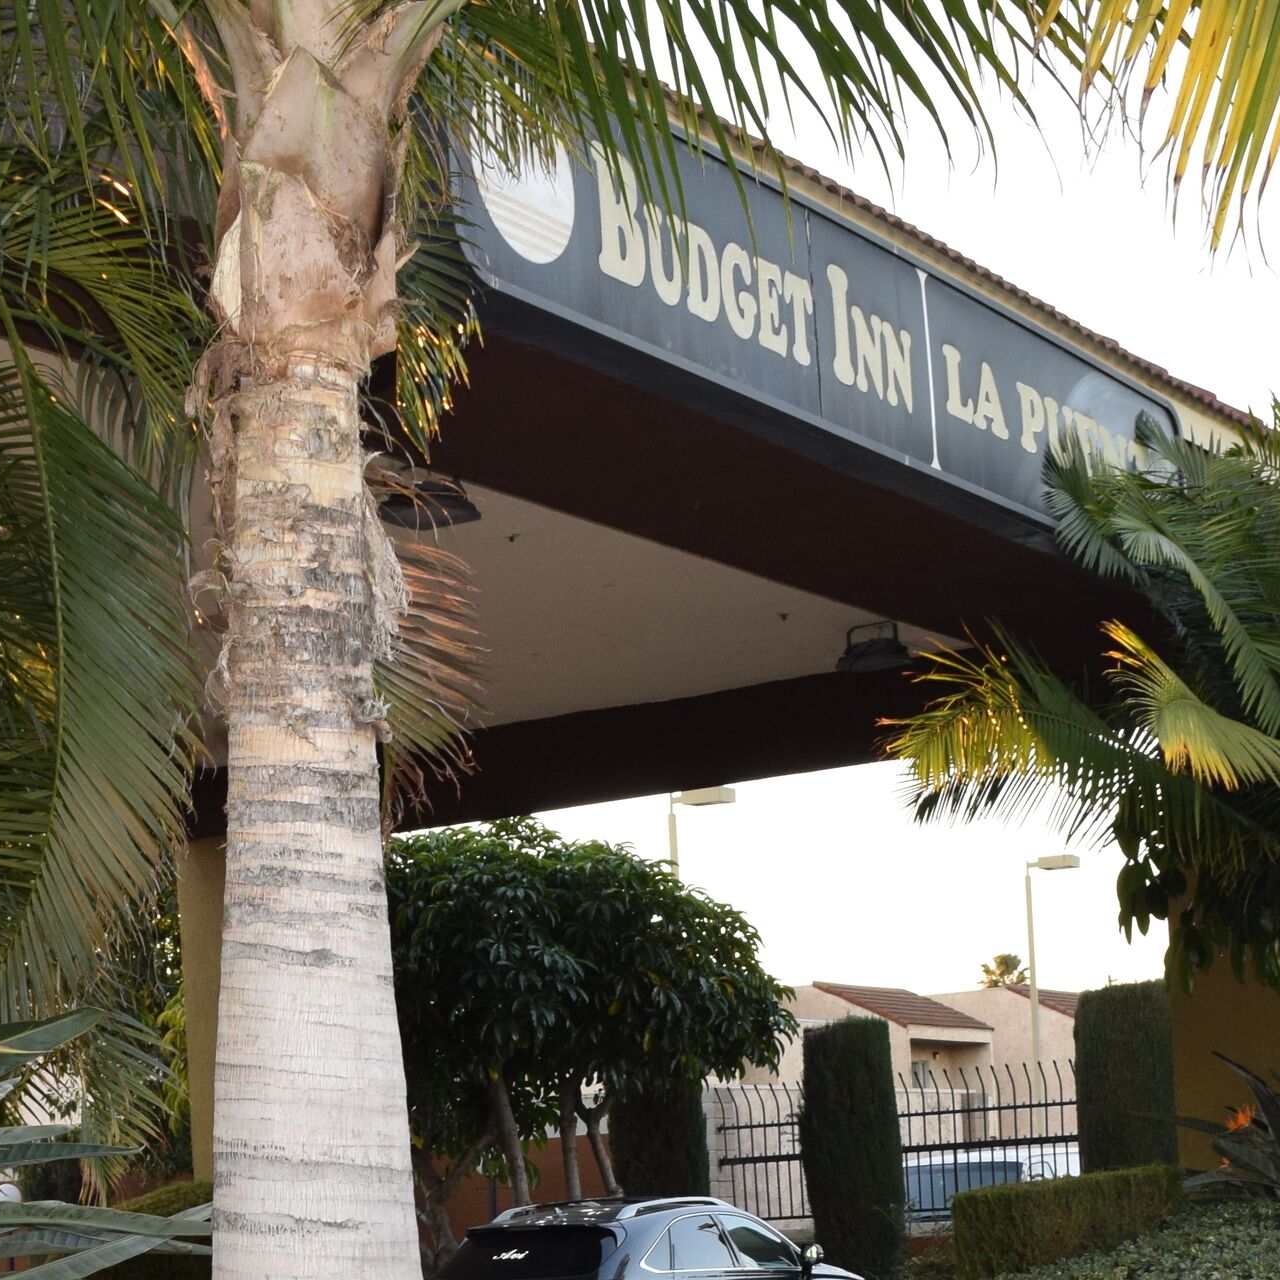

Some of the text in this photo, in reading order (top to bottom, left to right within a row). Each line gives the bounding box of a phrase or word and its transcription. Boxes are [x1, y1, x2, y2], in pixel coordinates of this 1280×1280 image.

[590, 140, 813, 366] BUDGET
[826, 263, 913, 414] INN
[942, 343, 1009, 440] LA
